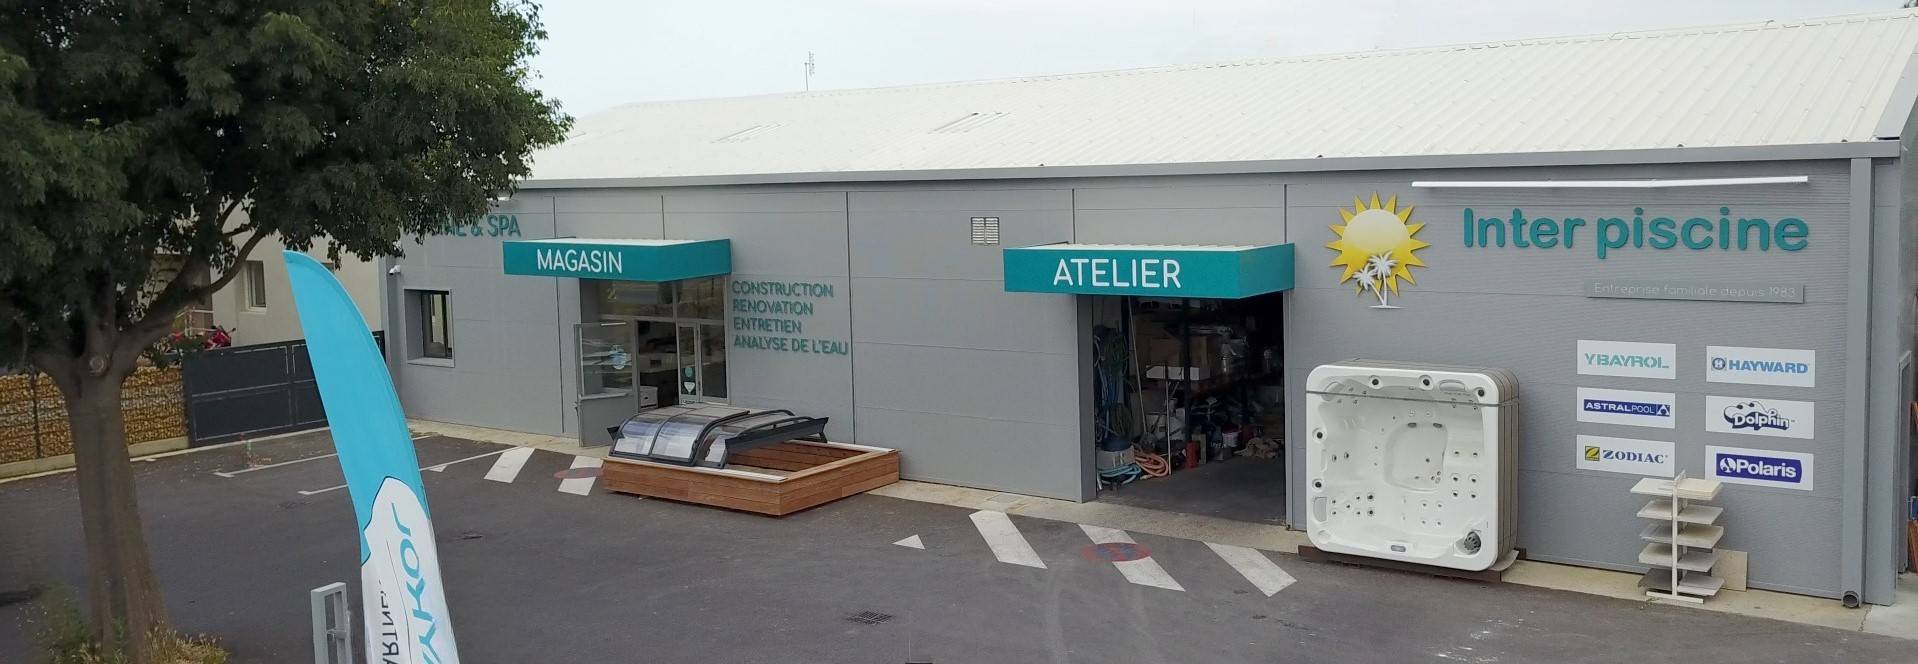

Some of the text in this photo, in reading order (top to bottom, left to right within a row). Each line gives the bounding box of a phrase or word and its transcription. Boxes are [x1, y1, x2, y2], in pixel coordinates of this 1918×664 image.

[487, 214, 521, 237] SPA
[1463, 206, 1810, 260] Inter piscine
[536, 249, 624, 274] MAGASIN
[1053, 258, 1182, 289] ATELIER
[732, 280, 834, 298] CONSTRUCTION
[1768, 286, 1796, 298] 1983
[733, 299, 814, 316] RENOVATION
[733, 317, 802, 334] ENTRETIEN
[734, 335, 849, 356] ANALYSE DE L'EAU
[1728, 359, 1808, 374] HAYWARD
[1733, 411, 1790, 431] Dolphin
[1602, 450, 1664, 464] ZODIAC
[1735, 458, 1798, 478] Polaris
